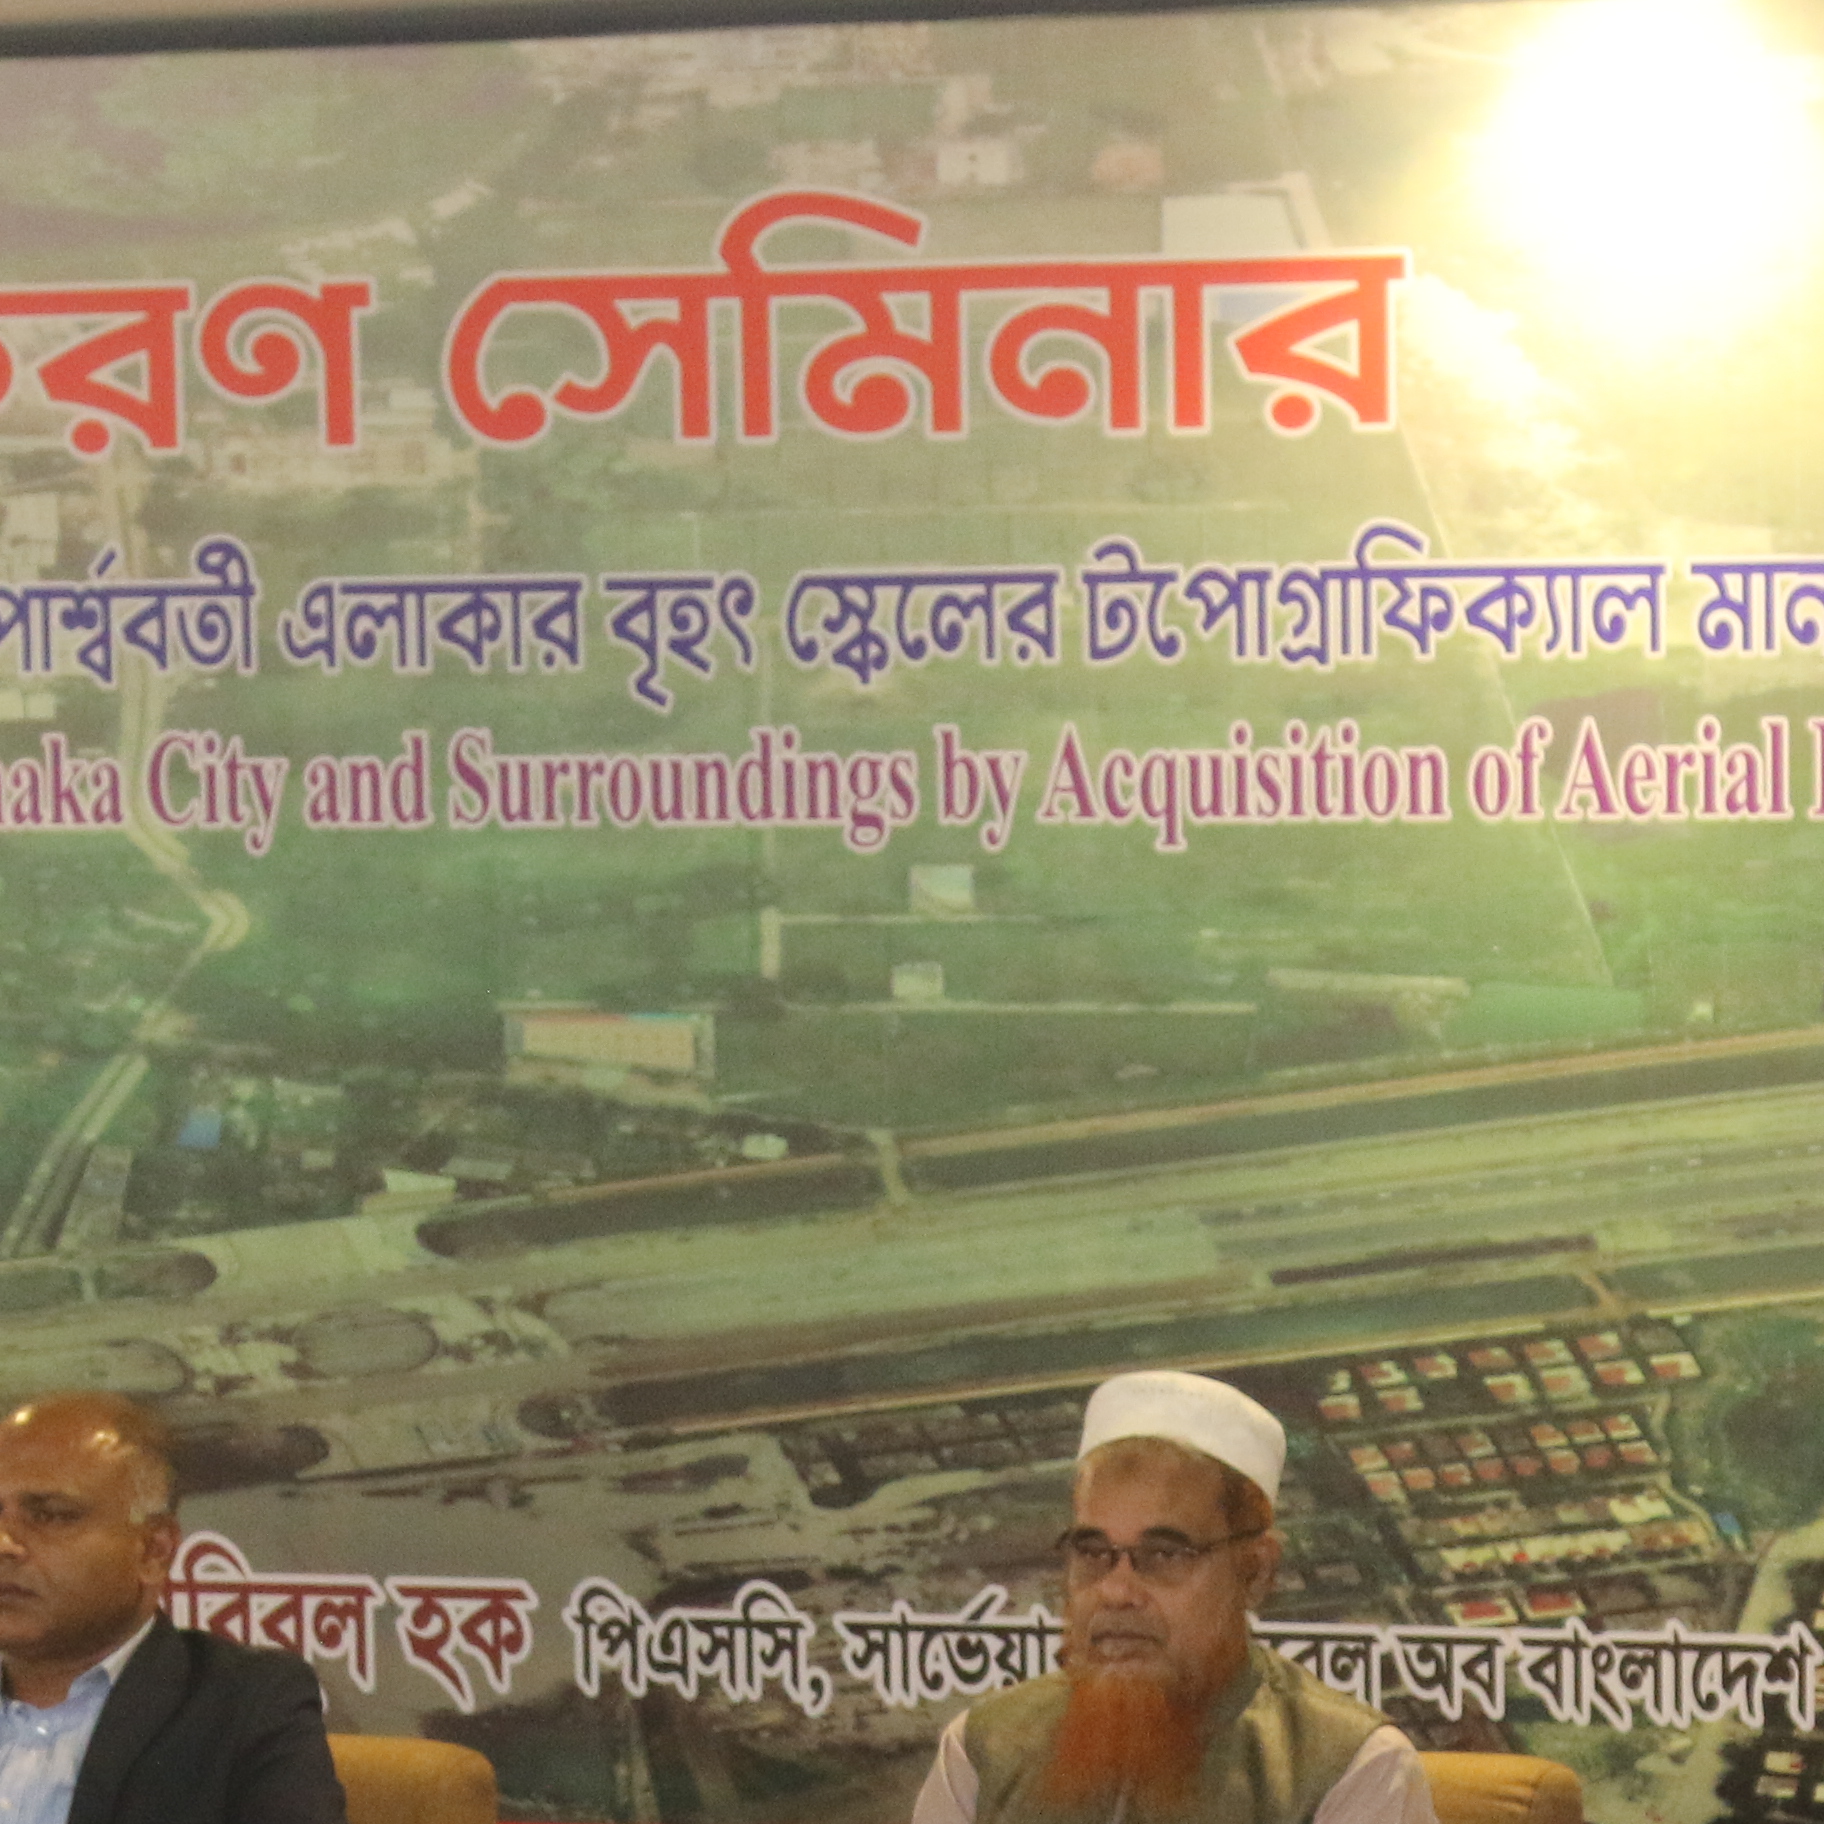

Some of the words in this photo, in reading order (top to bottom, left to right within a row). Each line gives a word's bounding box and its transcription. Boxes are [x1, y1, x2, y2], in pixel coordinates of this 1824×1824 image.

[447, 190, 1407, 444] সেমিনার
[282, 577, 584, 669] এলাকার
[603, 575, 757, 708] বৃহৎ
[785, 570, 1061, 686] স্কেলের
[1081, 525, 1667, 667] টপোগ্রাফিক্যাল
[147, 733, 288, 851] City
[306, 734, 430, 824] and
[451, 730, 917, 848] Surroundings
[936, 727, 1025, 848] by
[1041, 723, 1448, 848] Acquisition
[1471, 720, 1549, 817] of
[1558, 716, 1790, 816] Aerial
[388, 1585, 531, 1704] হক
[572, 1583, 827, 1708] পিএসসি,
[1393, 1633, 1505, 1714] অব
[1516, 1625, 1819, 1724] বাংলাদেশ
